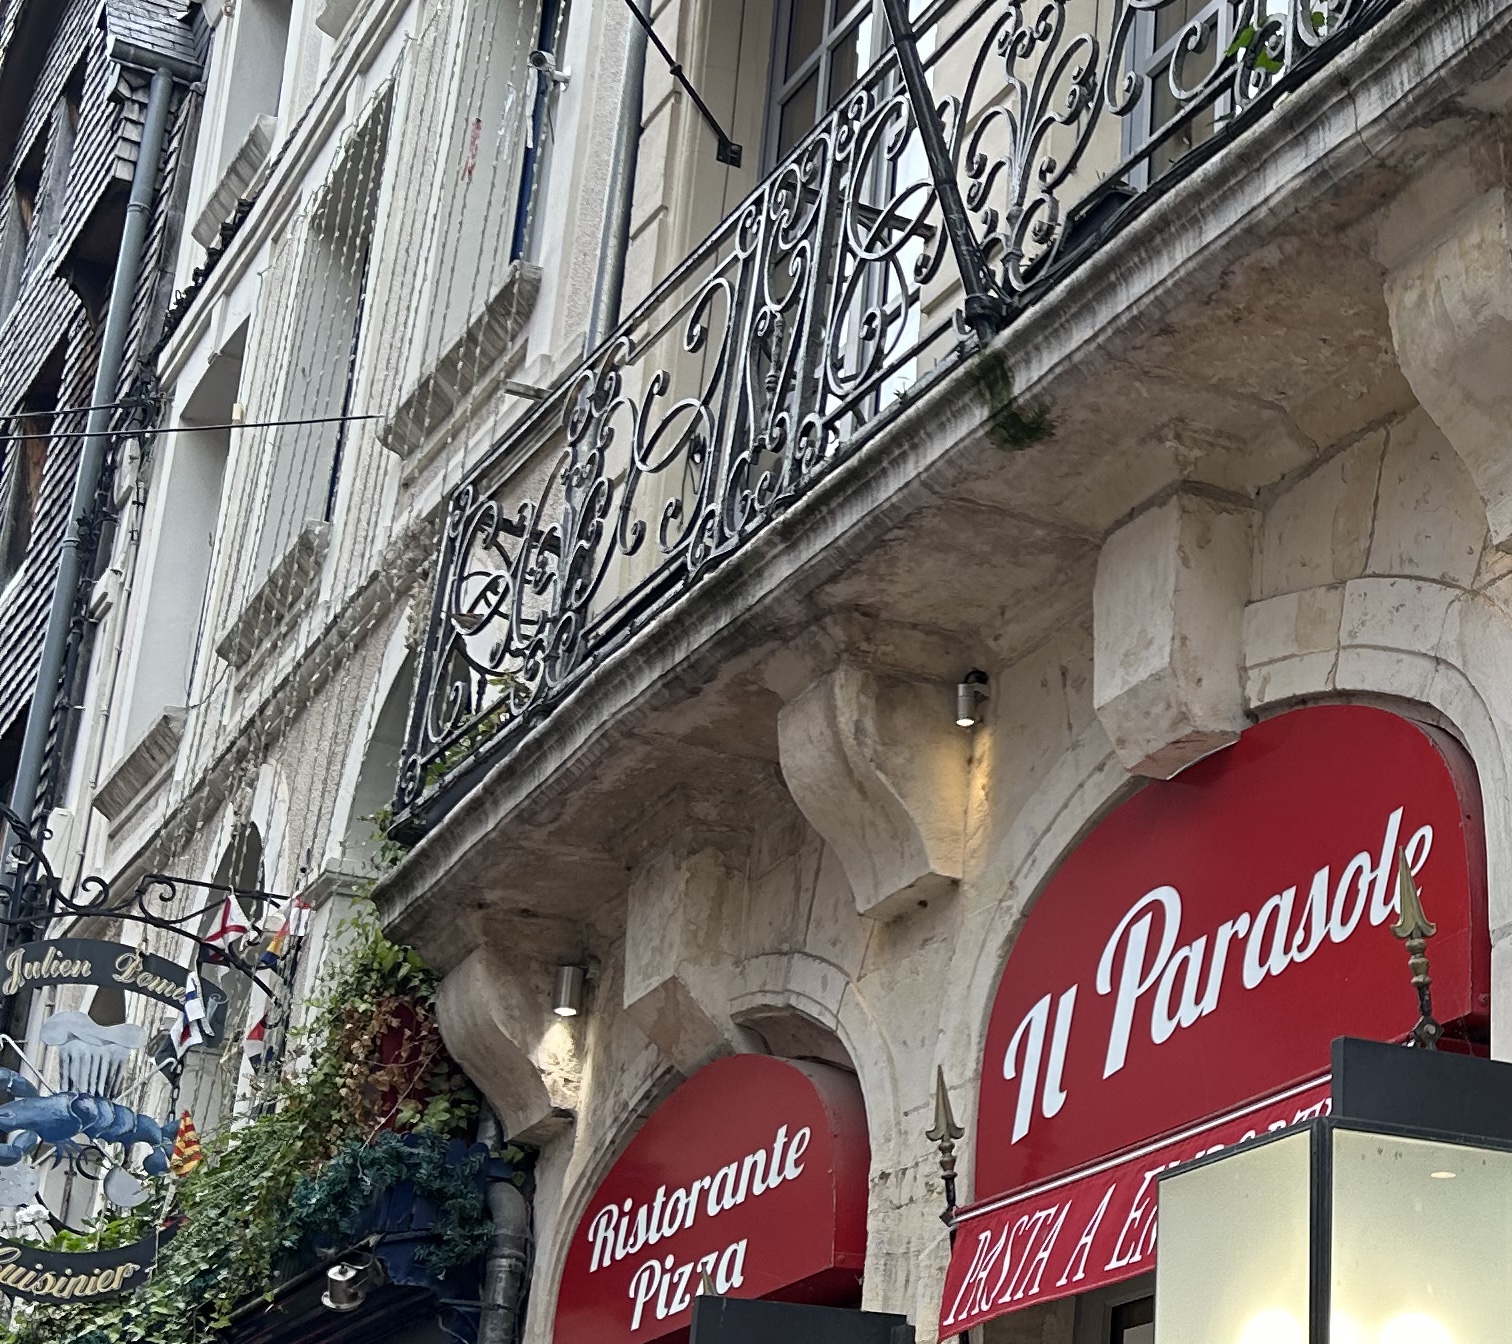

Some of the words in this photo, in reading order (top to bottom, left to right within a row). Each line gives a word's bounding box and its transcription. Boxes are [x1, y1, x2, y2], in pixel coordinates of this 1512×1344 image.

[3, 946, 92, 996] Julien
[1003, 983, 1079, 1146] Il
[1096, 805, 1434, 1080] Parasole
[587, 1123, 812, 1274] Ristorante
[942, 1199, 1073, 1327] PASTA
[1055, 1182, 1117, 1288] A
[628, 1237, 749, 1332] Pizza
